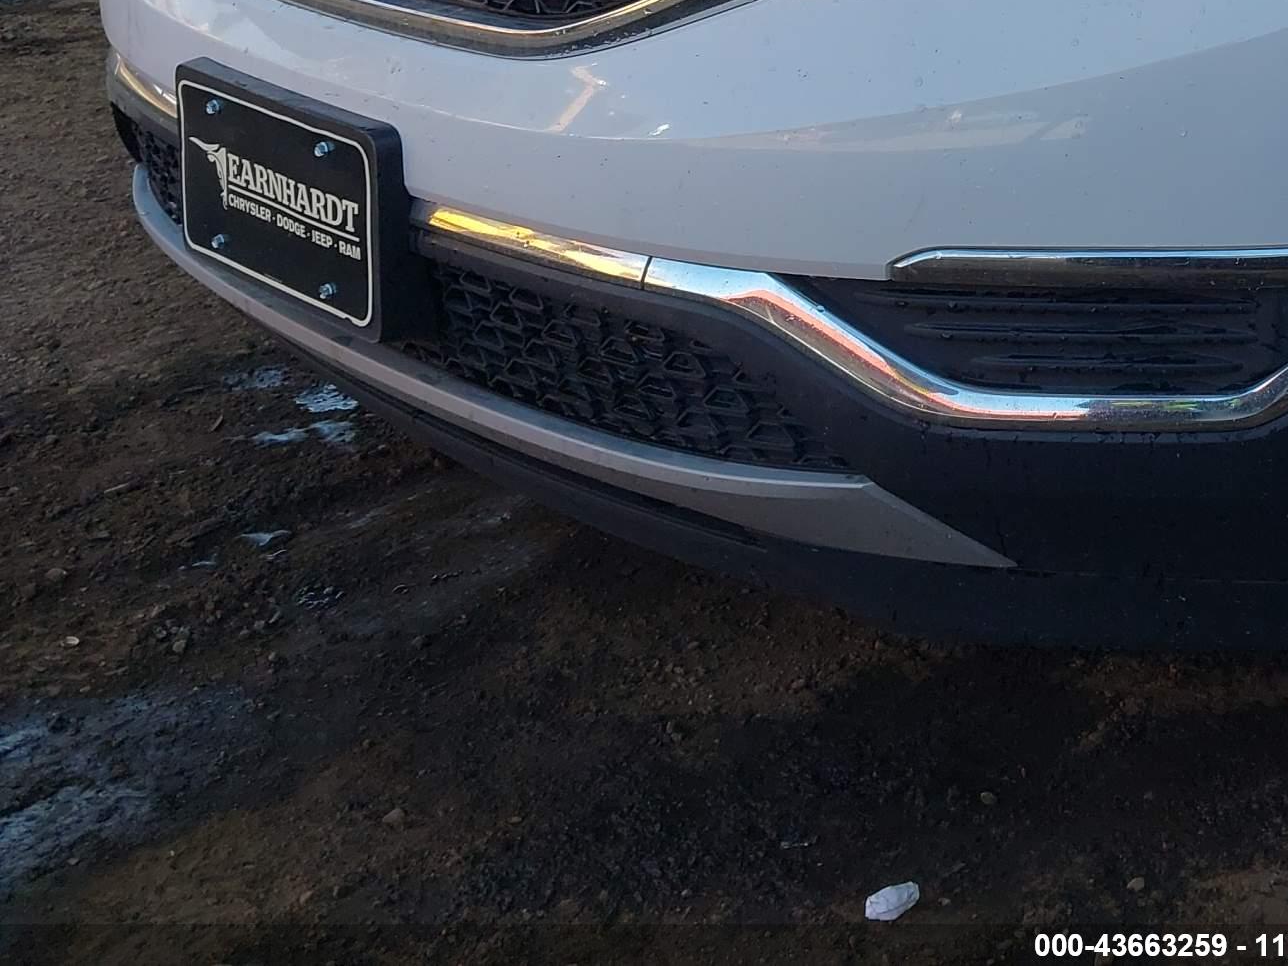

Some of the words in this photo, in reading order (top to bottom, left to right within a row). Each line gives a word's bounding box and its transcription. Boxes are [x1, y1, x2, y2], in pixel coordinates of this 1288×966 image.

[227, 152, 359, 233] EARNHARDT
[228, 193, 272, 223] CHRYSLER
[276, 213, 306, 238] DODGE
[311, 229, 333, 250] JEEP
[338, 242, 362, 261] RAM
